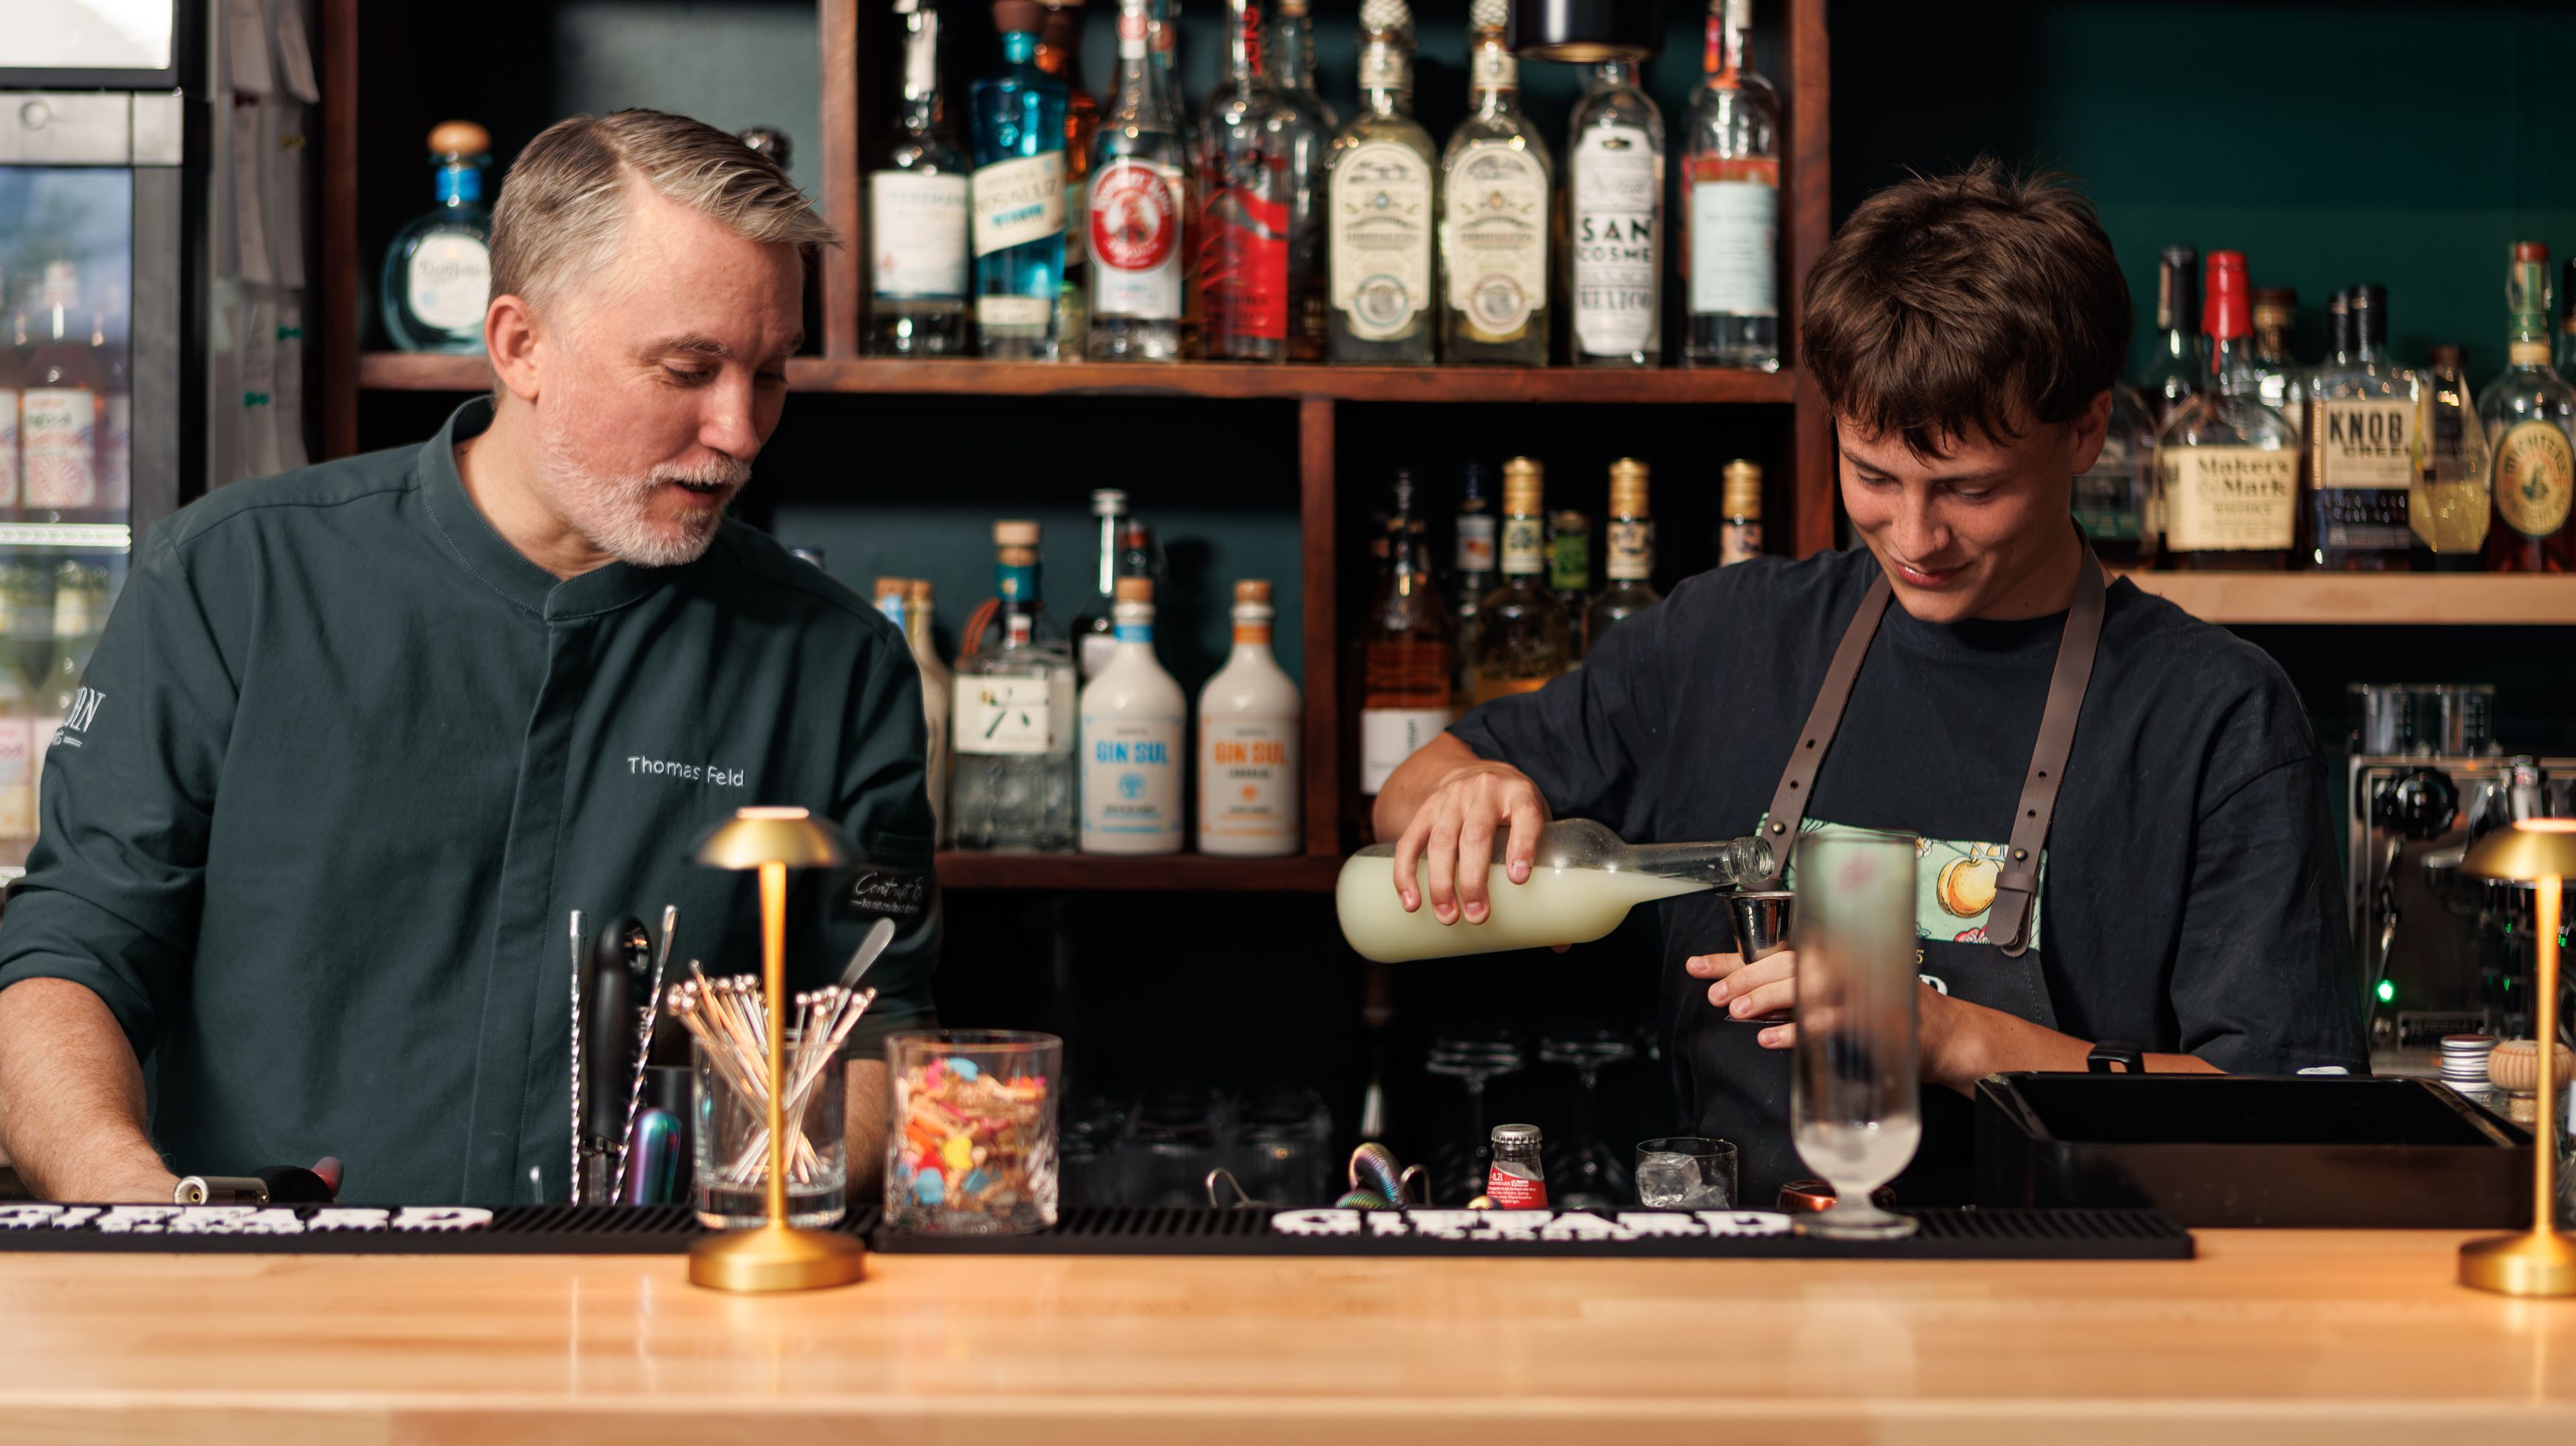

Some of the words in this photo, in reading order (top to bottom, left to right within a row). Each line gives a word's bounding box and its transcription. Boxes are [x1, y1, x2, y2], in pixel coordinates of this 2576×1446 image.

[1580, 216, 1652, 242] SAN
[1578, 246, 1653, 263] COSME
[2329, 411, 2403, 444] KNOB
[2198, 457, 2289, 474] Maker's
[2224, 478, 2287, 496] Mark
[1096, 740, 1129, 764] GIN
[1134, 741, 1168, 765] SUL
[1214, 739, 1248, 765] GIN
[1251, 740, 1289, 766] SUL
[627, 755, 701, 780] Thomas
[706, 764, 745, 787] Feld
